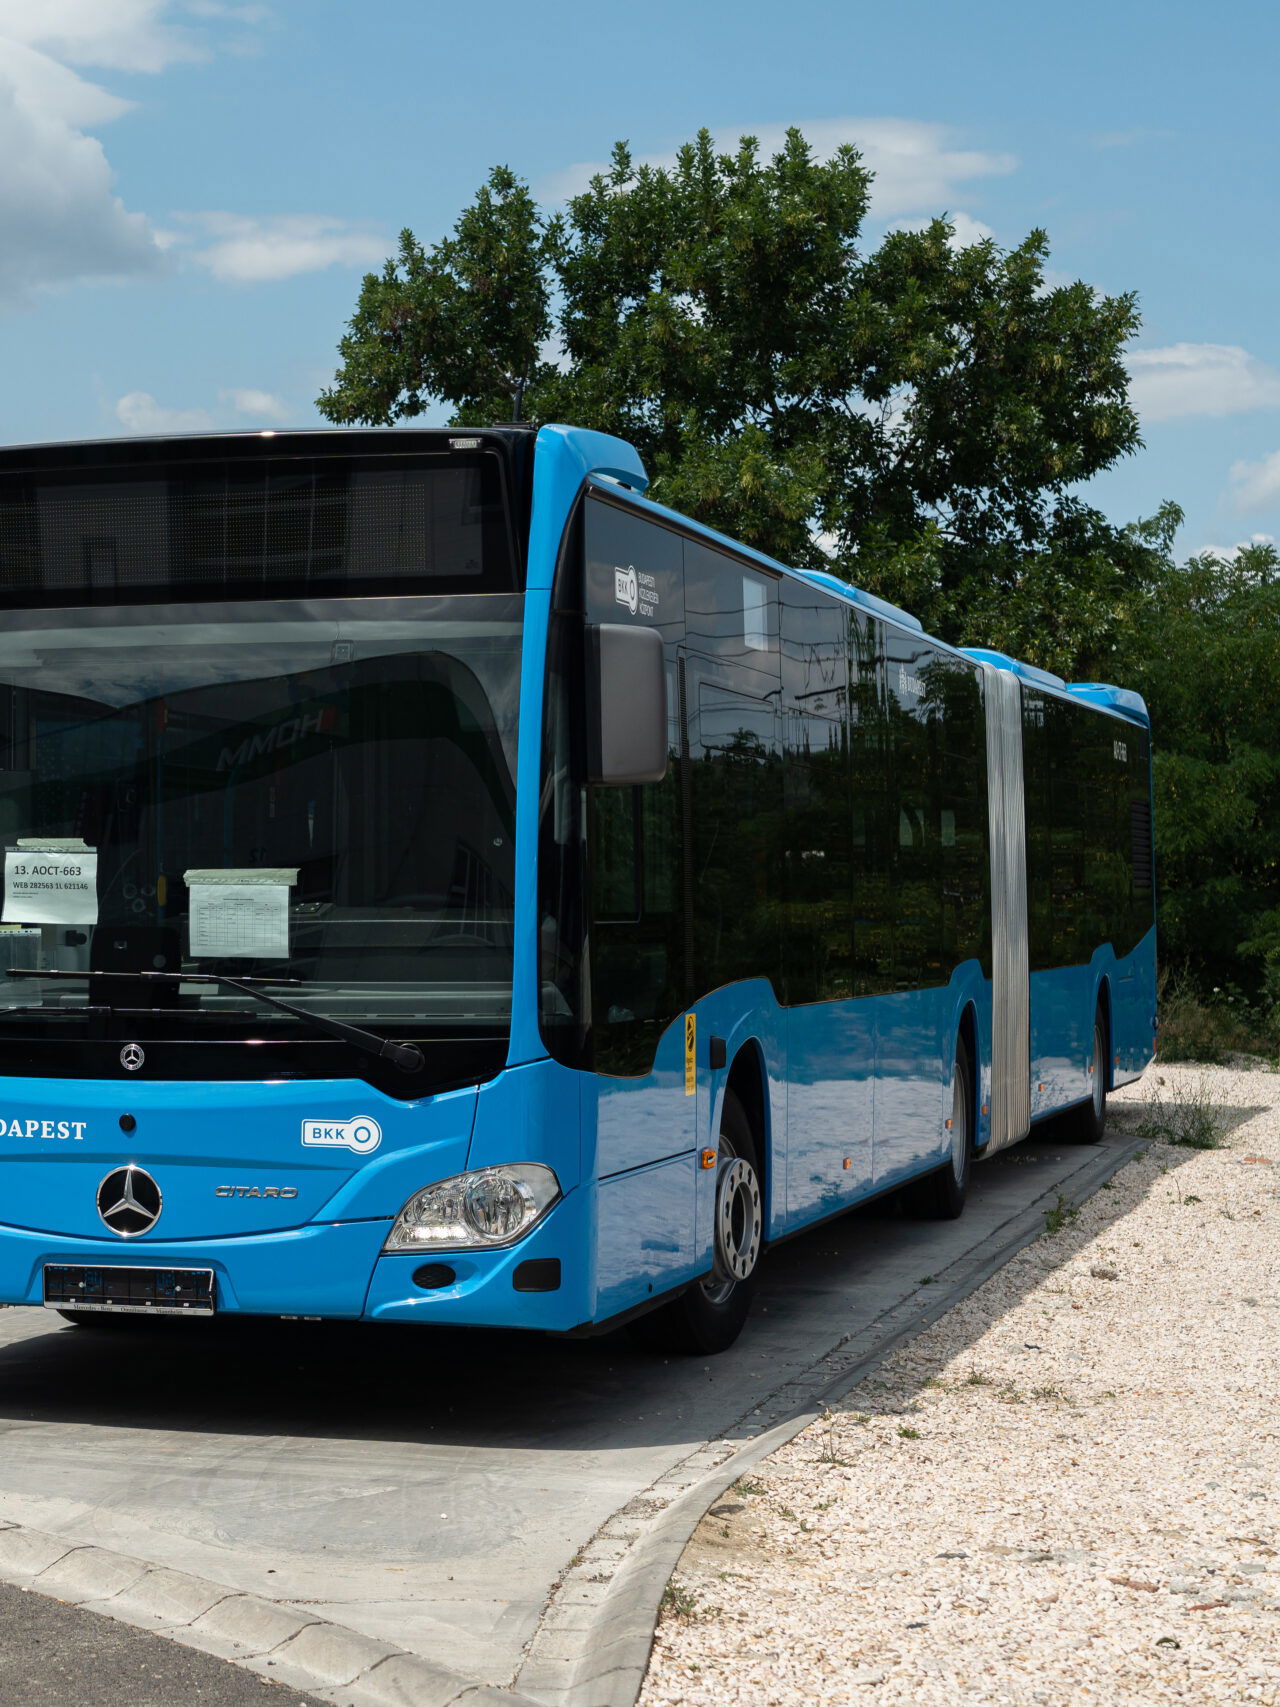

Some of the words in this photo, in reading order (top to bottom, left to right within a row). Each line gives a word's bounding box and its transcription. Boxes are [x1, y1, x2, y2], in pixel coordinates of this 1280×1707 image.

[14, 865, 29, 875] 13.
[32, 866, 82, 876] AOCT-663
[13, 881, 28, 889] WEB
[30, 882, 53, 890] 282563
[312, 1127, 345, 1140] BKK
[215, 1185, 298, 1198] CITARO
